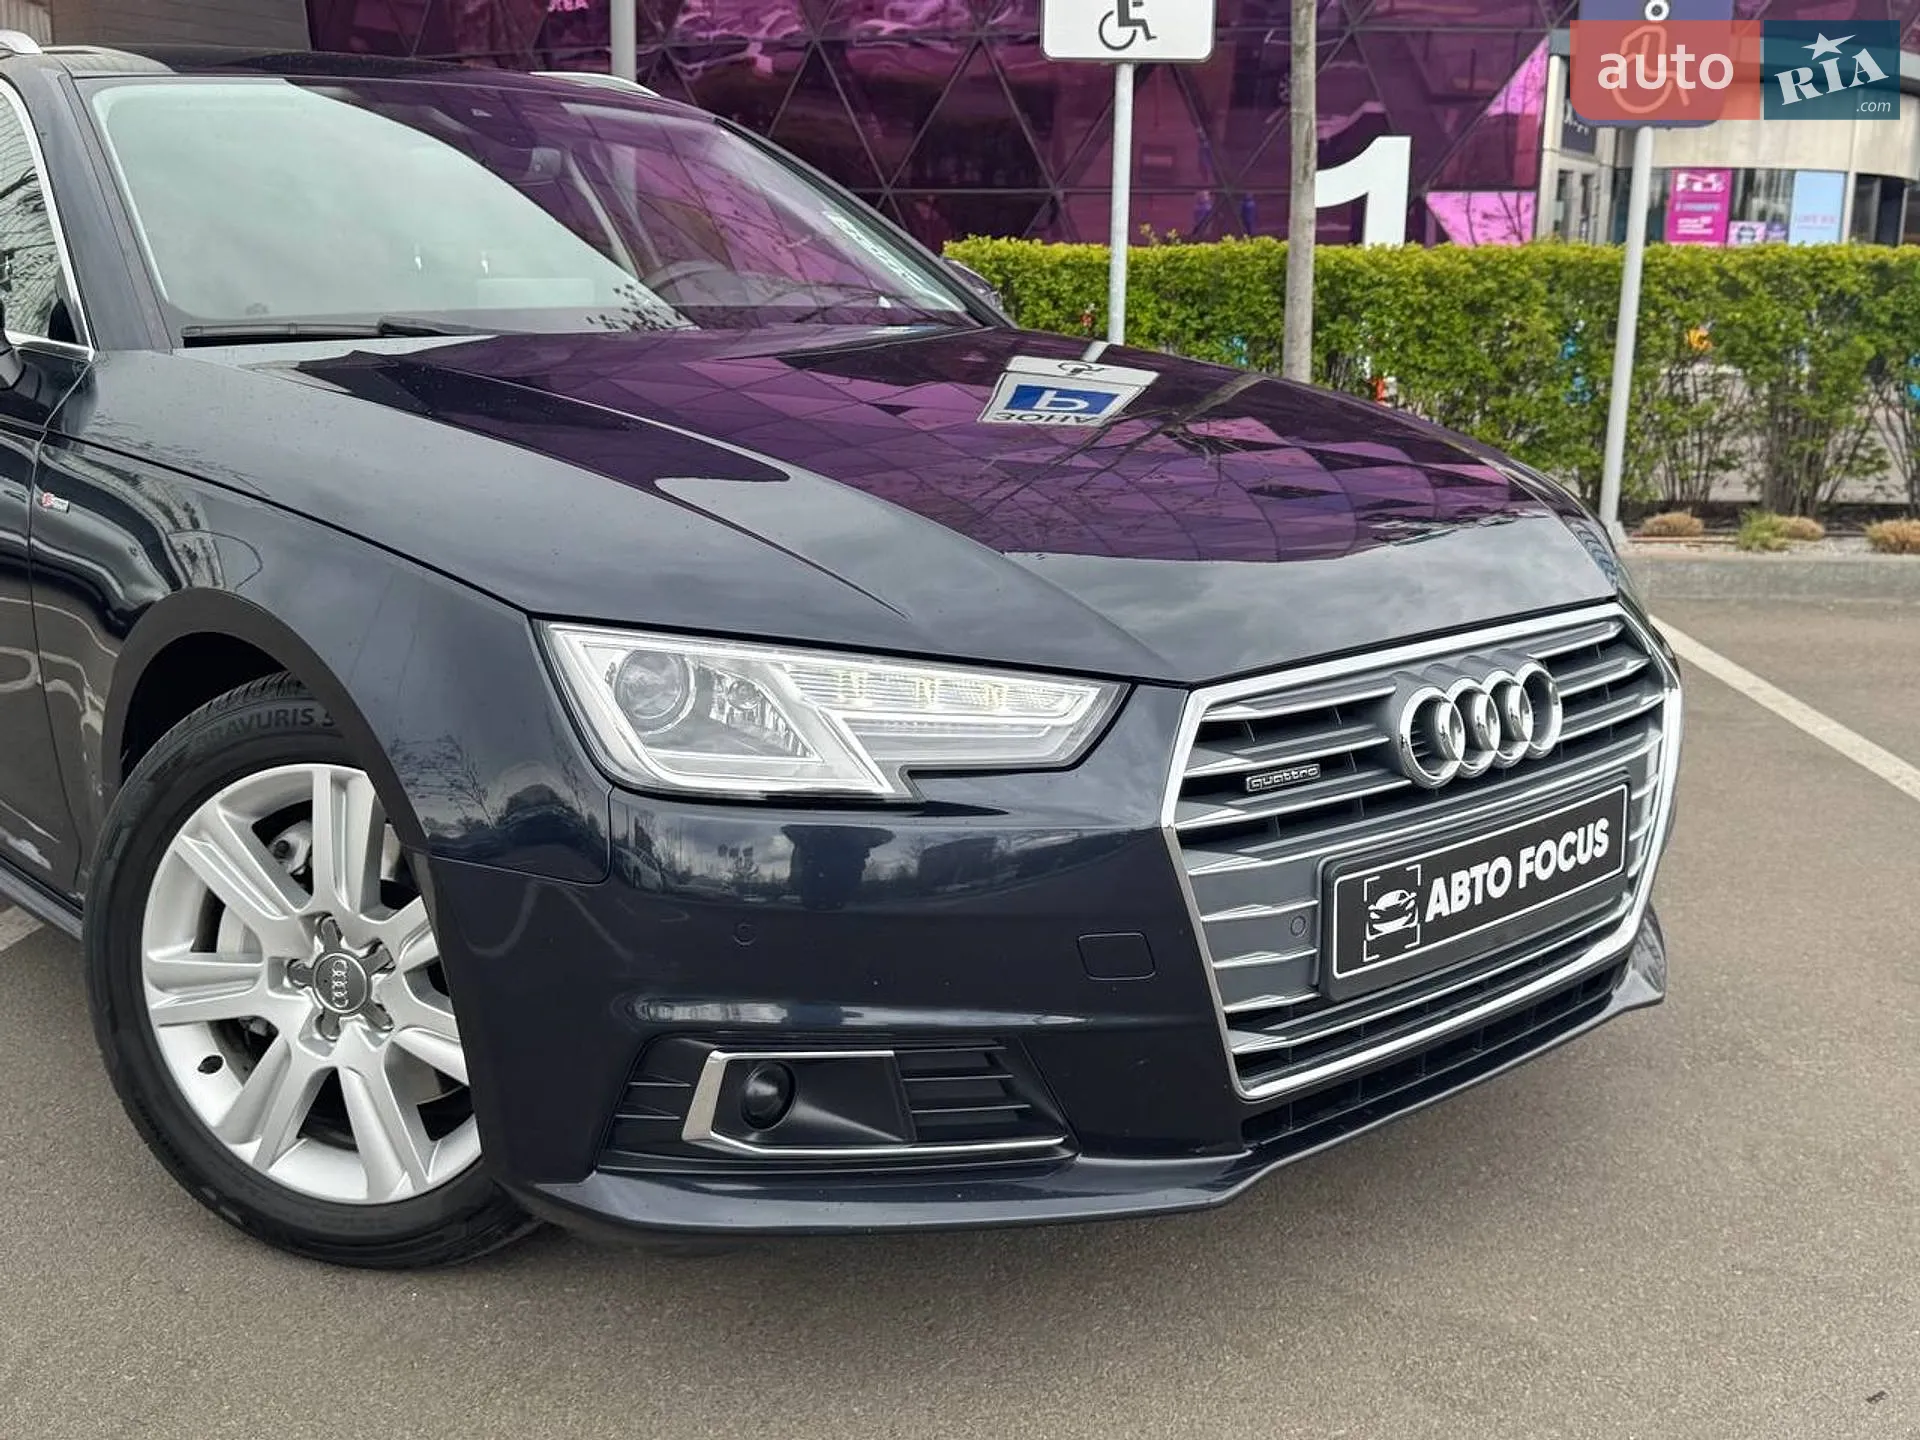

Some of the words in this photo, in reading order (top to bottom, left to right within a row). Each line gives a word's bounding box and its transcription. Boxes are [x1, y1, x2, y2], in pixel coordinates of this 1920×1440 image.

[1251, 767, 1318, 790] quattro
[1425, 856, 1512, 923] АВТО
[1518, 818, 1609, 889] FOCUS
